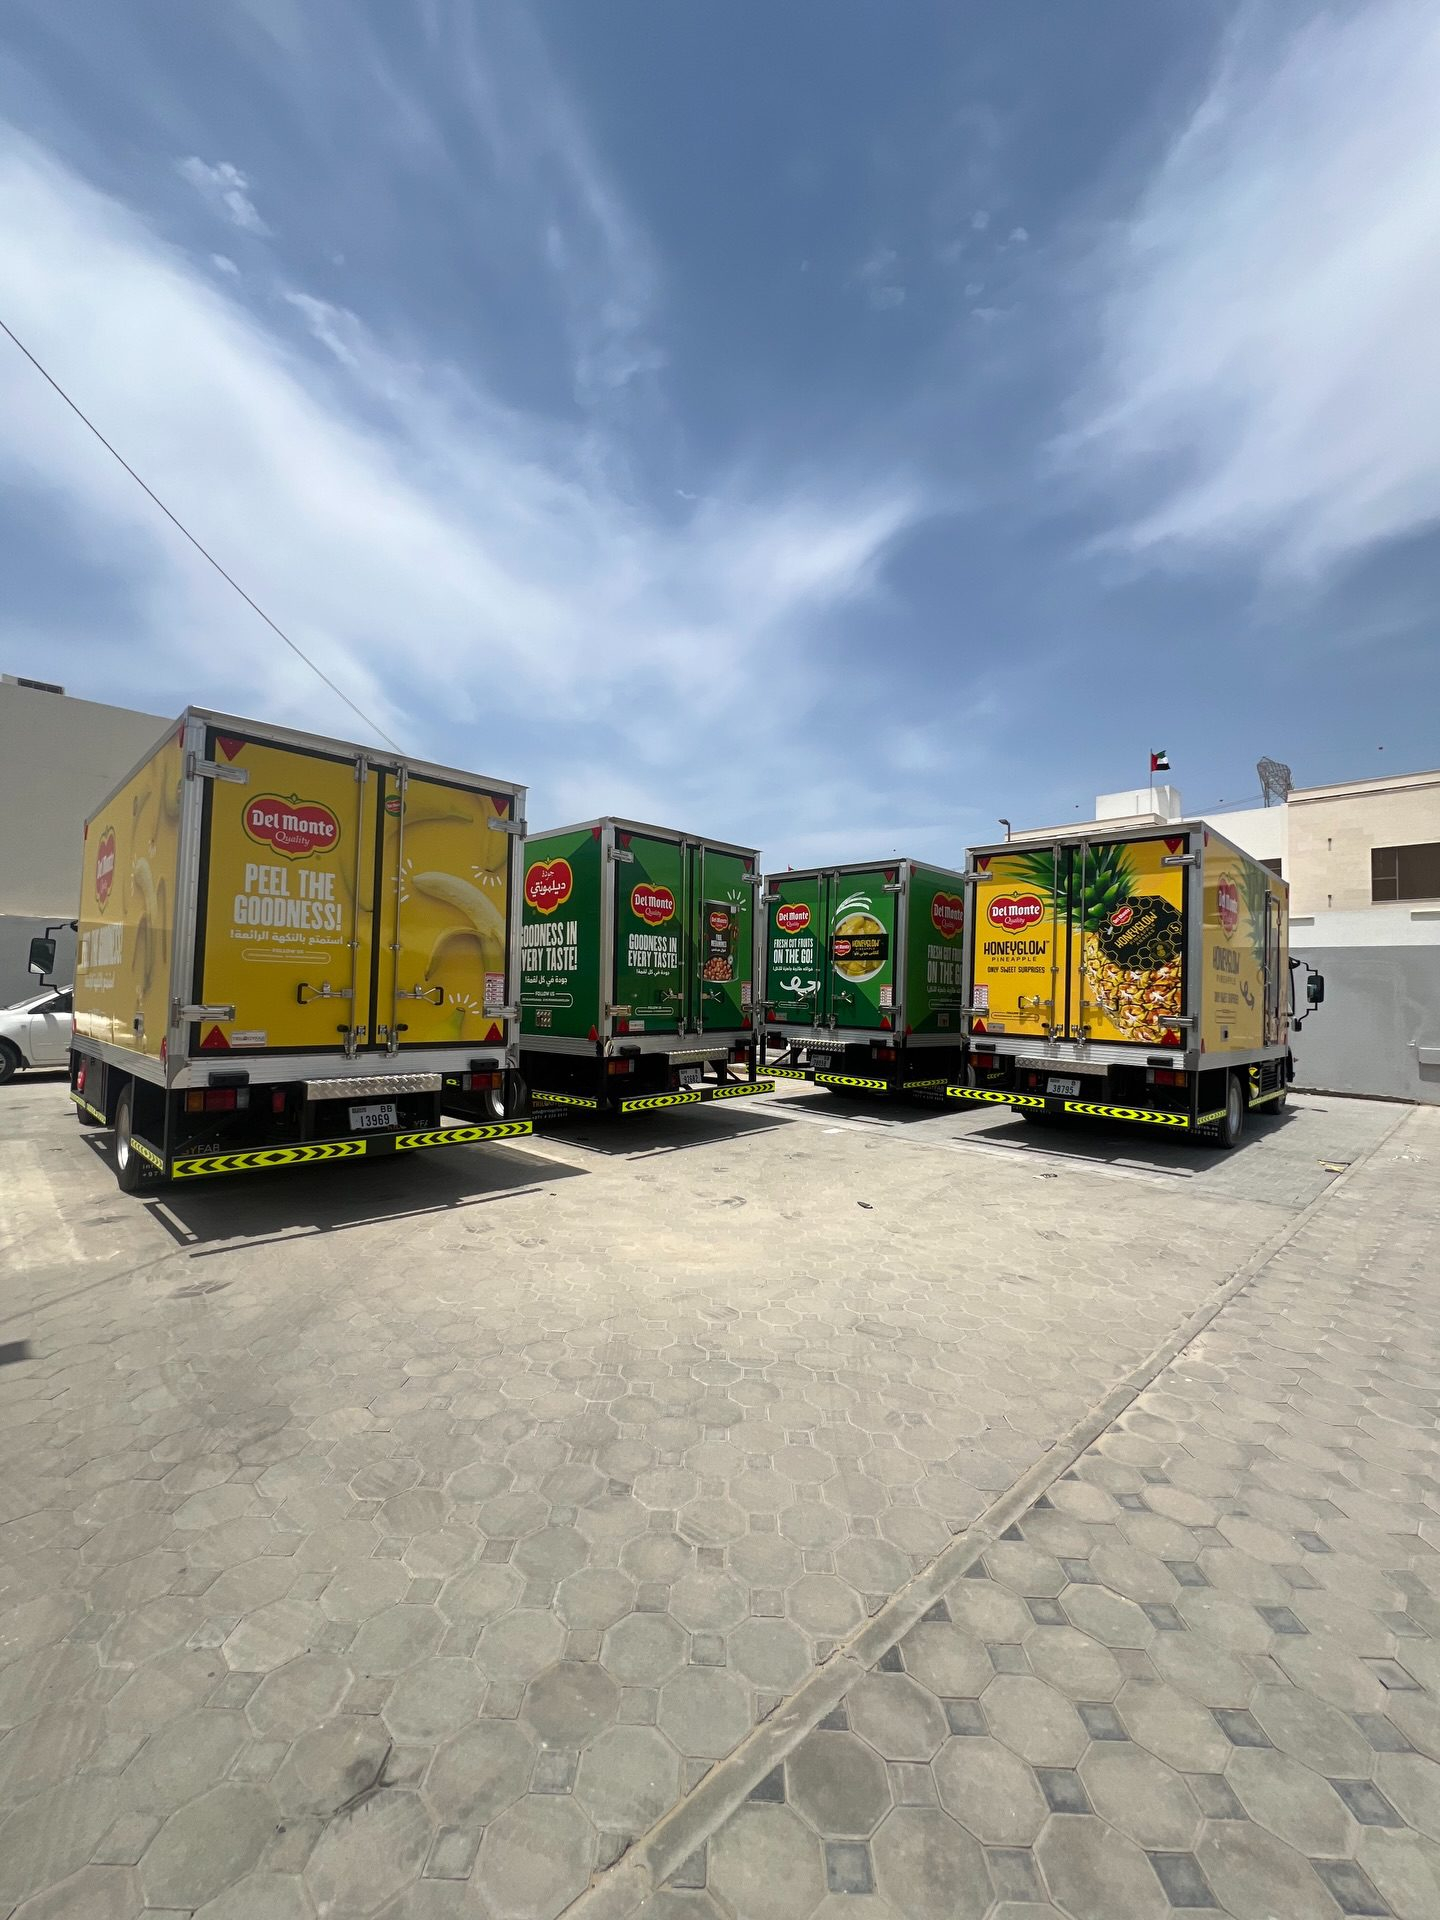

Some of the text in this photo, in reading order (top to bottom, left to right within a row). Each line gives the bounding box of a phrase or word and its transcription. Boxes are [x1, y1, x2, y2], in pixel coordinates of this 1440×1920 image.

[252, 809, 334, 837] Del Monte
[275, 831, 310, 847] Quality
[245, 863, 336, 901] PEEL THE
[530, 880, 566, 898] ديلمونتي
[634, 894, 673, 910] Del Monte
[234, 895, 342, 931] GOODNESS!
[779, 911, 809, 921] Del Monte
[934, 904, 964, 921] Del Monte
[992, 905, 1040, 917] Del Monte
[1004, 916, 1025, 925] Quality
[566, 921, 578, 945] IN
[1114, 911, 1158, 949] HONEYGLOW
[272, 933, 306, 944] بالنكهة
[309, 936, 343, 945] استمتع
[628, 933, 677, 953] GOODNESS IN
[774, 938, 814, 948] FRESH CUT FRUITS
[520, 946, 578, 971] VERY TASTE!
[628, 950, 678, 969] EVERY TASTE!
[773, 948, 813, 964] ON THE GO!
[928, 961, 938, 984] ON
[939, 962, 954, 985] THE
[1018, 966, 1045, 974] SURPRISES
[545, 976, 555, 987] في
[555, 976, 568, 985] جودة
[380, 1105, 393, 1113] BB
[360, 1113, 390, 1127] 13969
